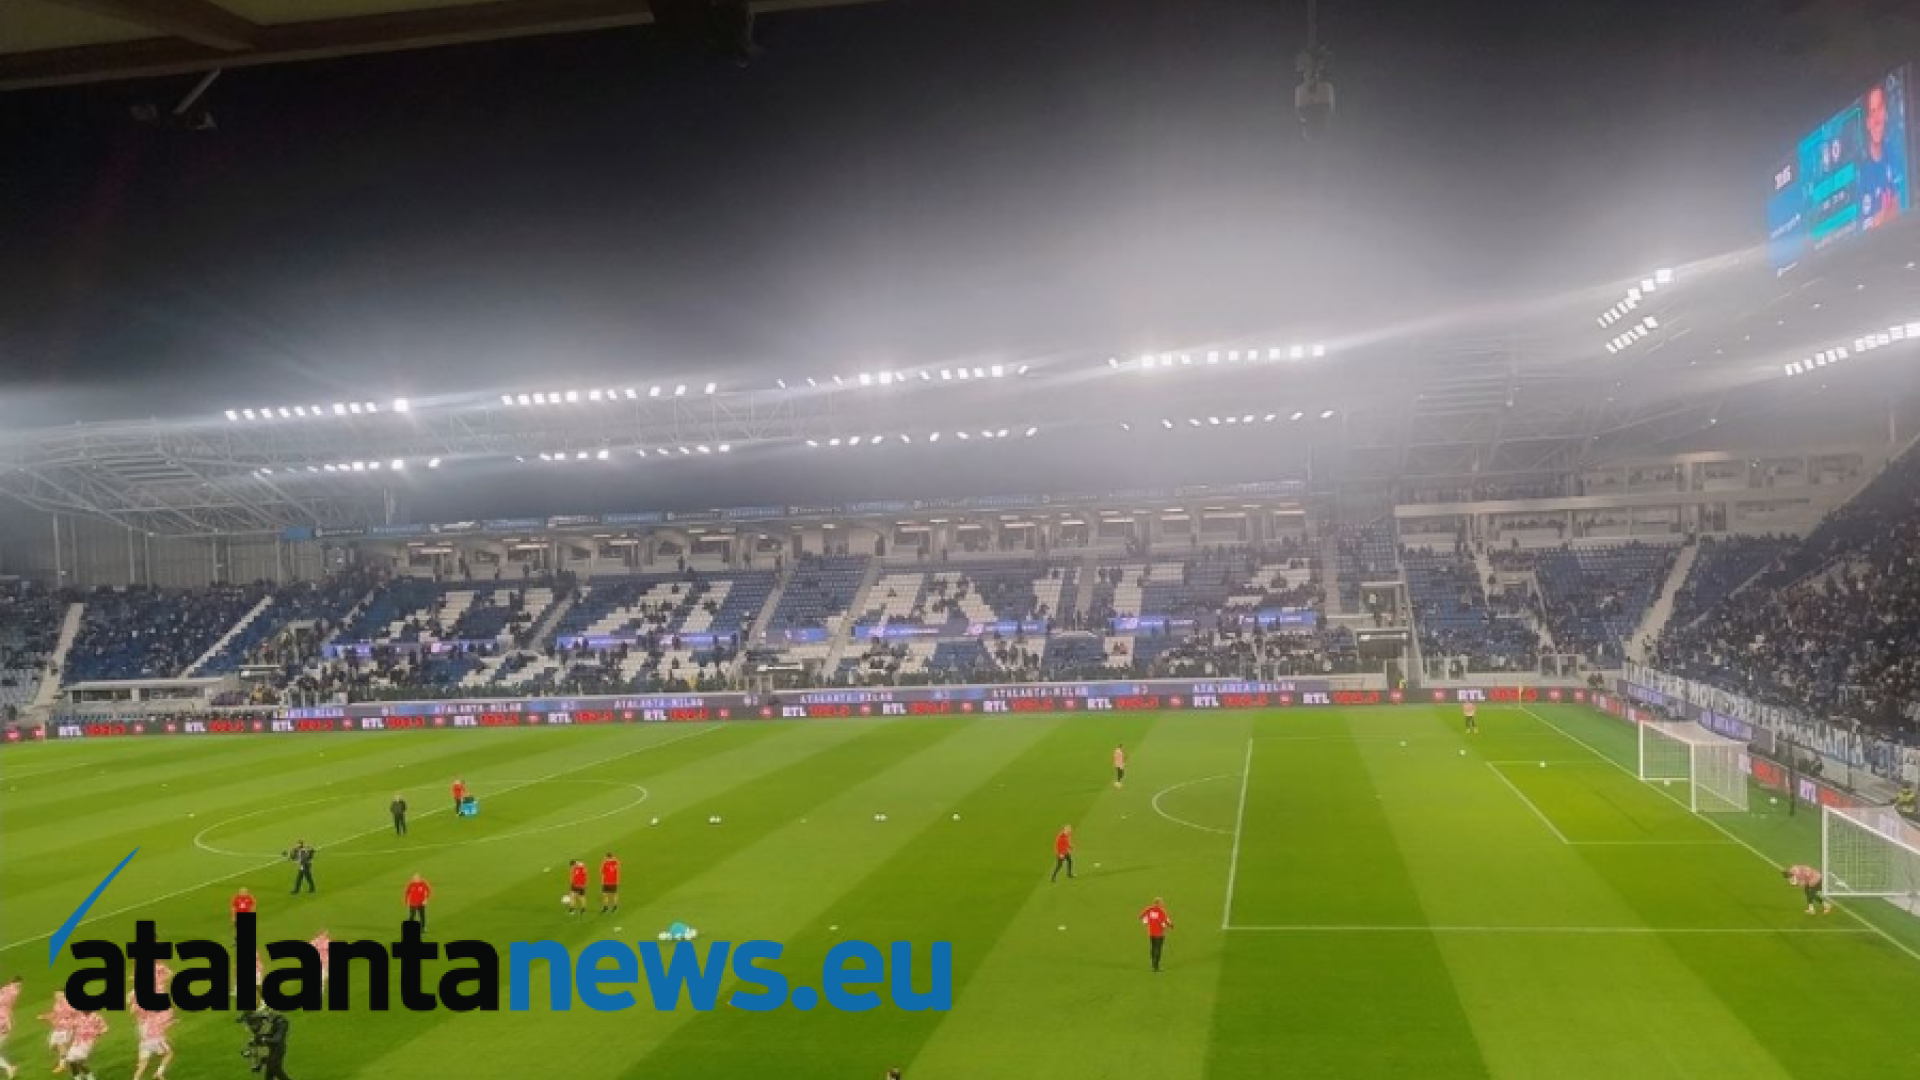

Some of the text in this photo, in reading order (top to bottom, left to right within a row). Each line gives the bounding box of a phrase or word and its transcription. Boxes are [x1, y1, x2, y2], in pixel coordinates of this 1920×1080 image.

[1302, 692, 1330, 704] RTL
[1457, 689, 1486, 701] RTL
[1087, 698, 1112, 709] RTL
[1193, 696, 1219, 708] RTL
[782, 706, 806, 717] RTL
